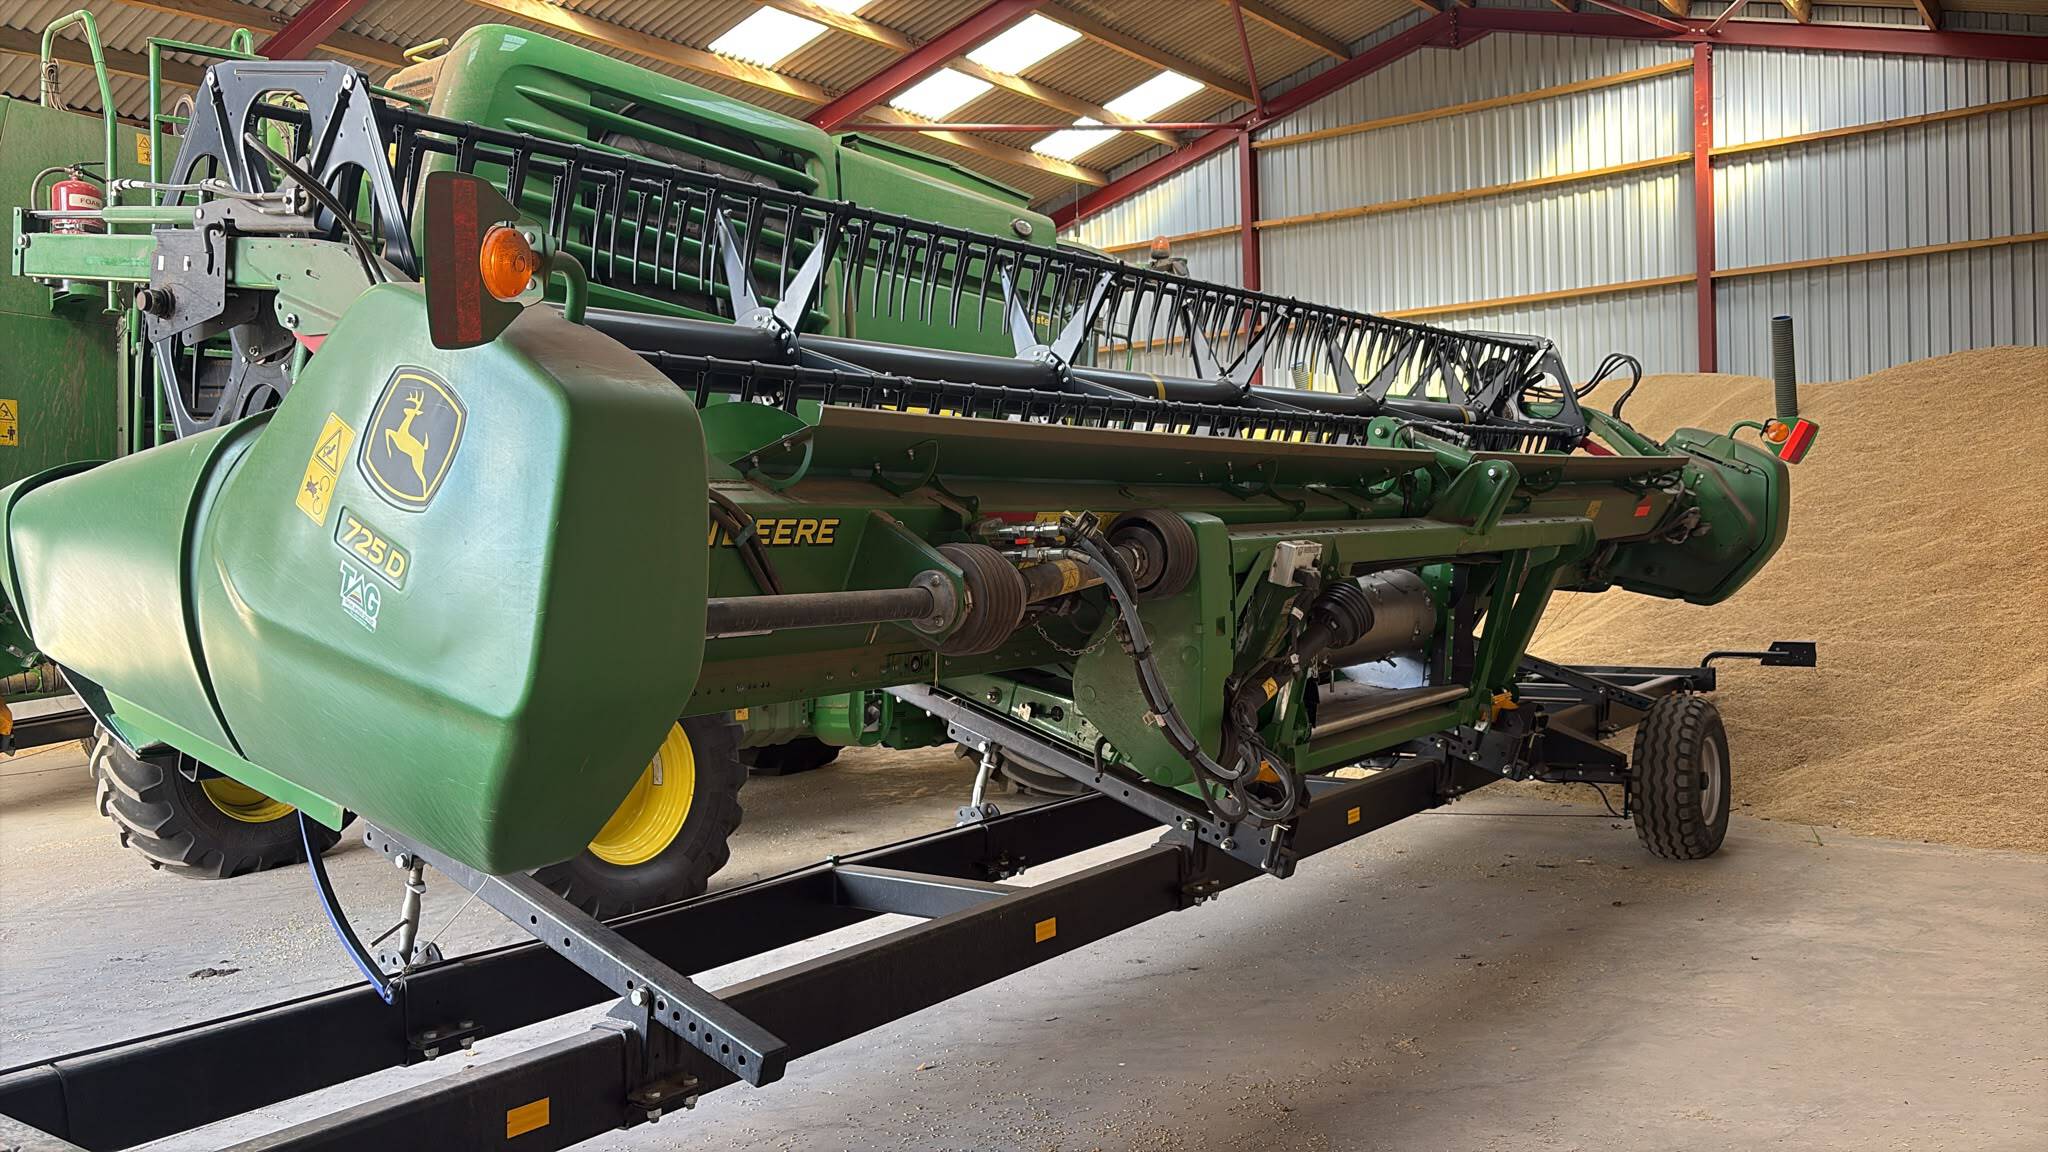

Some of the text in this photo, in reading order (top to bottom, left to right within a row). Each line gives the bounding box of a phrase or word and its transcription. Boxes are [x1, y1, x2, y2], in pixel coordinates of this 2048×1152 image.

[342, 516, 406, 578] 725 D
[340, 560, 381, 619] TAG
